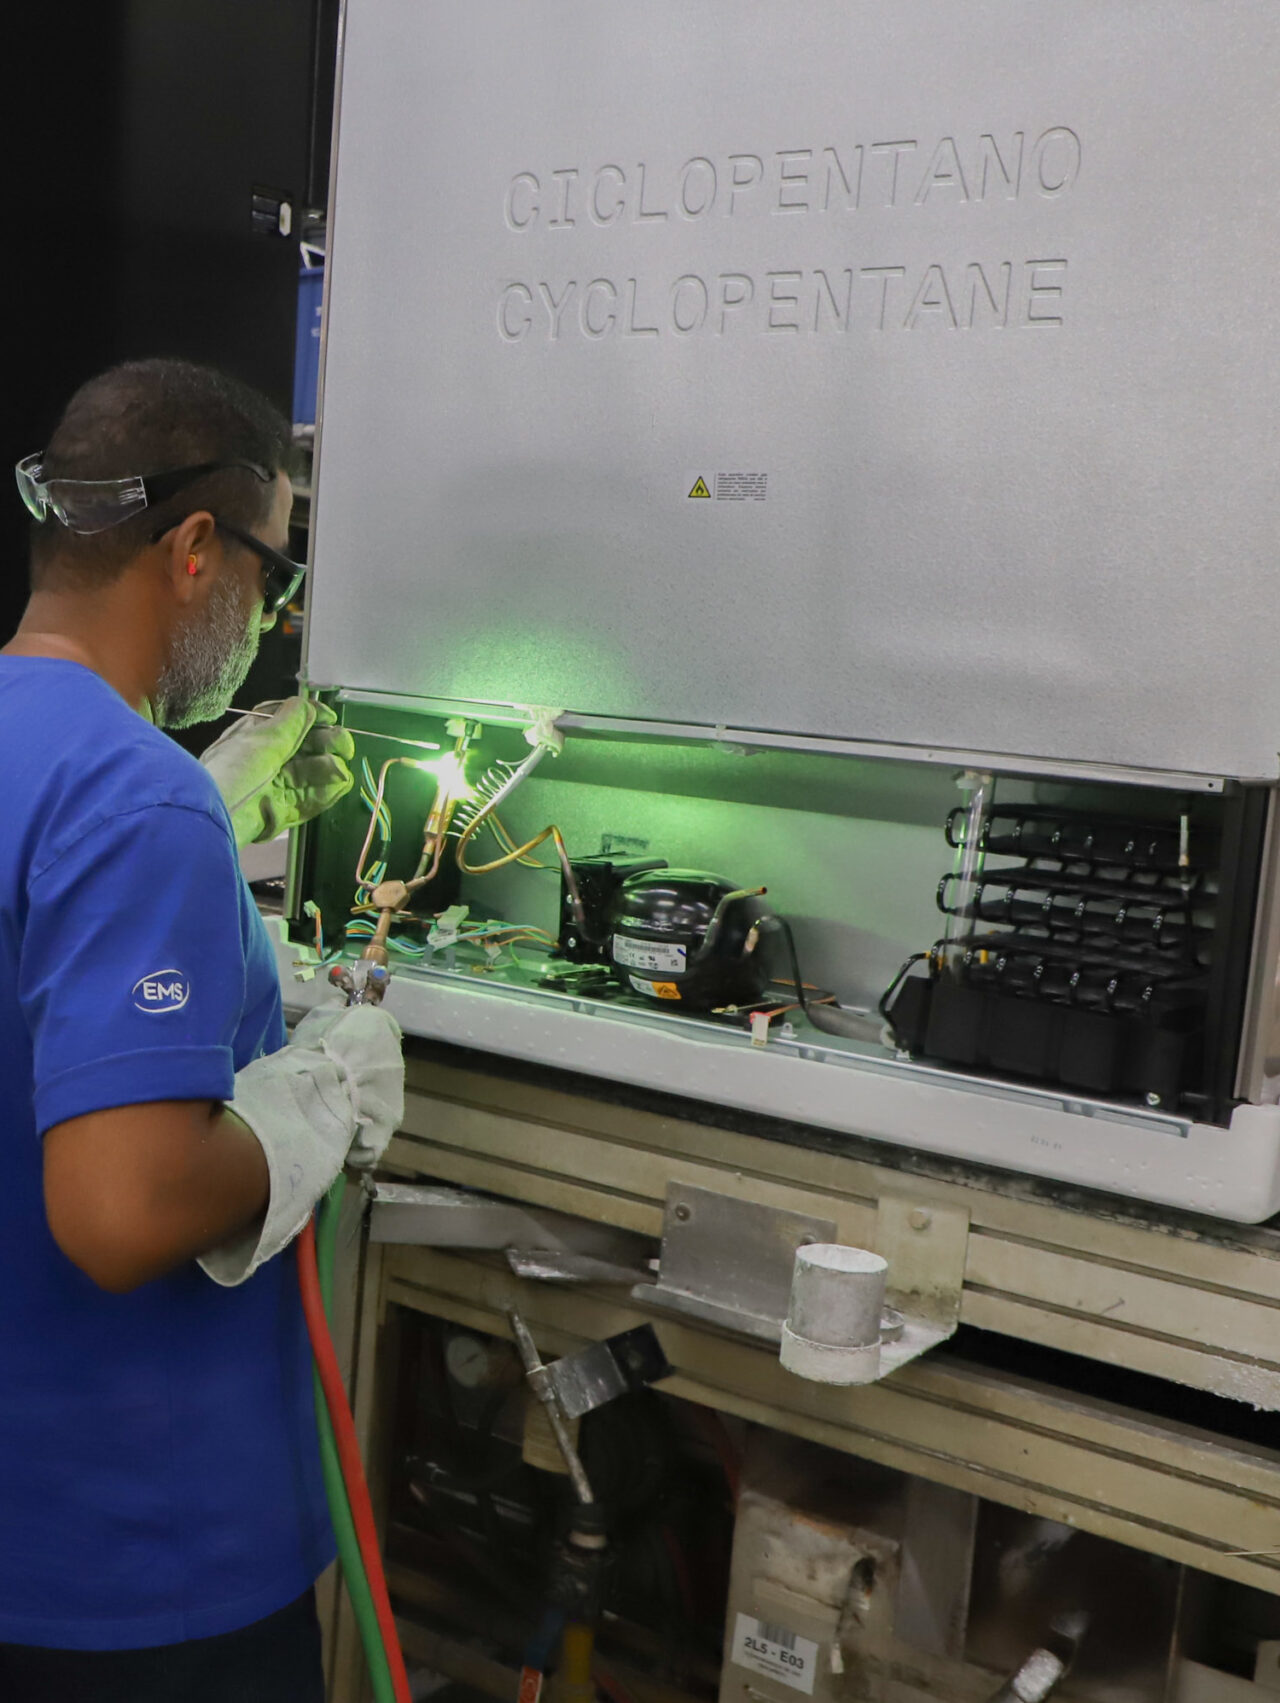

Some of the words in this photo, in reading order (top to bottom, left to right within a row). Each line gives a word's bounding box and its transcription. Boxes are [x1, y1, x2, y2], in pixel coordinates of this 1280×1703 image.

[504, 126, 1081, 233] CICLOPENTANO
[496, 259, 1068, 343] CYCLOPENTANE
[143, 982, 183, 1001] EMS
[780, 1650, 805, 1669] E03
